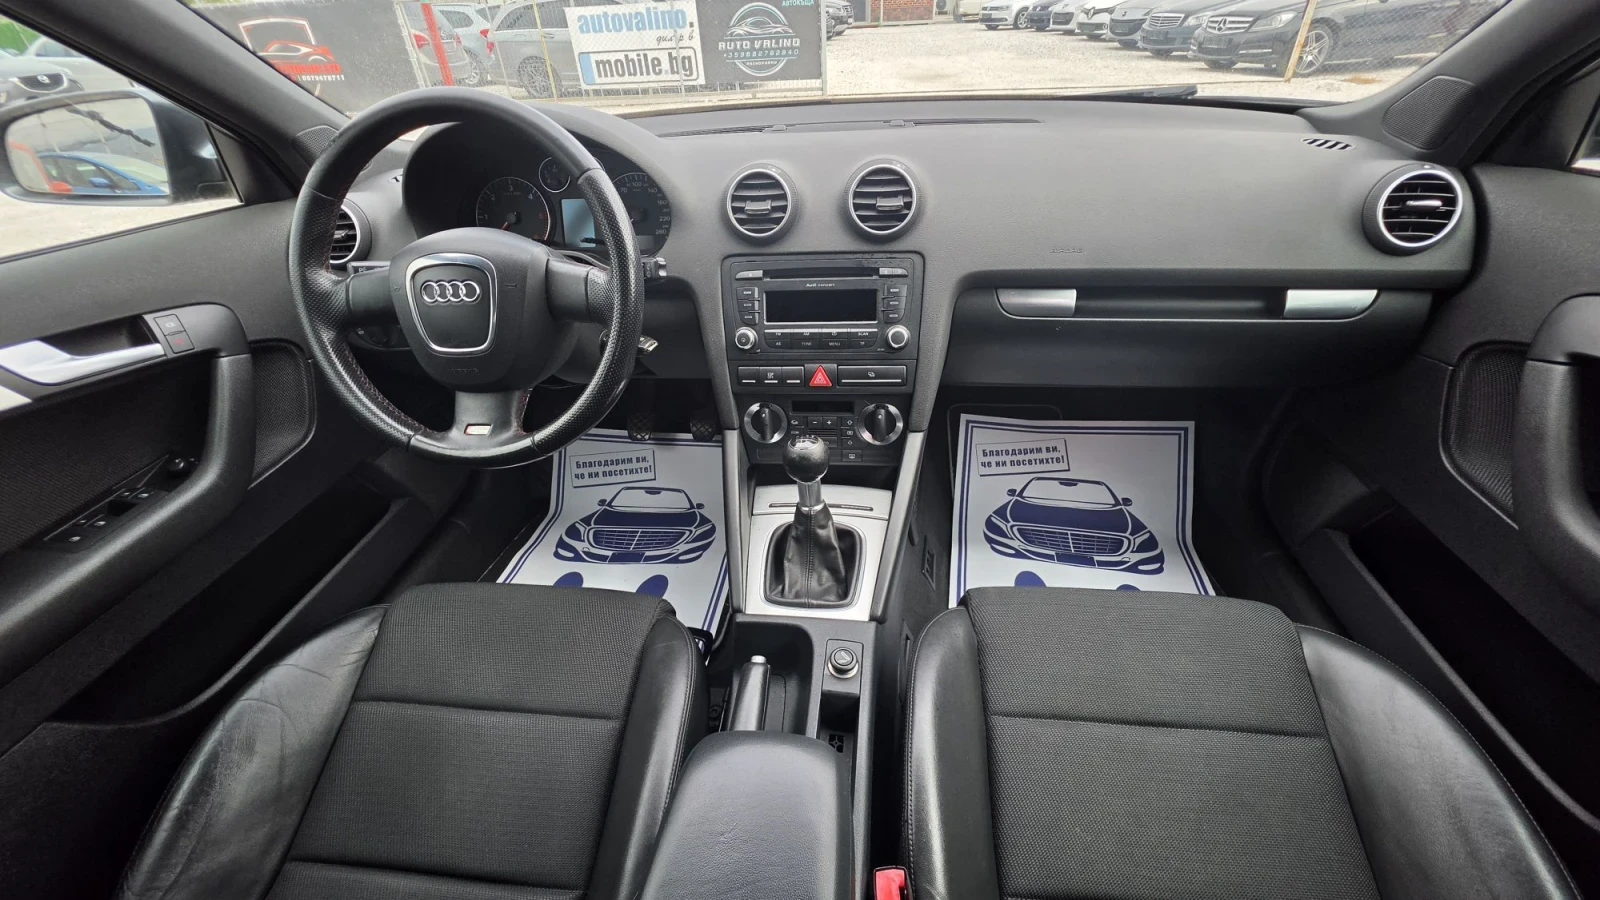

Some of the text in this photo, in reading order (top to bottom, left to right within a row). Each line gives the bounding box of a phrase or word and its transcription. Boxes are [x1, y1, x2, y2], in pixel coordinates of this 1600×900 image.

[718, 38, 801, 51] AUTO VALINO
[594, 52, 694, 79] mobile.bg
[982, 446, 1043, 458] Благодарим
[575, 456, 633, 470] Благодарим
[980, 455, 1065, 469] че ни посетихте!
[574, 464, 652, 481] че ни посетихте!
